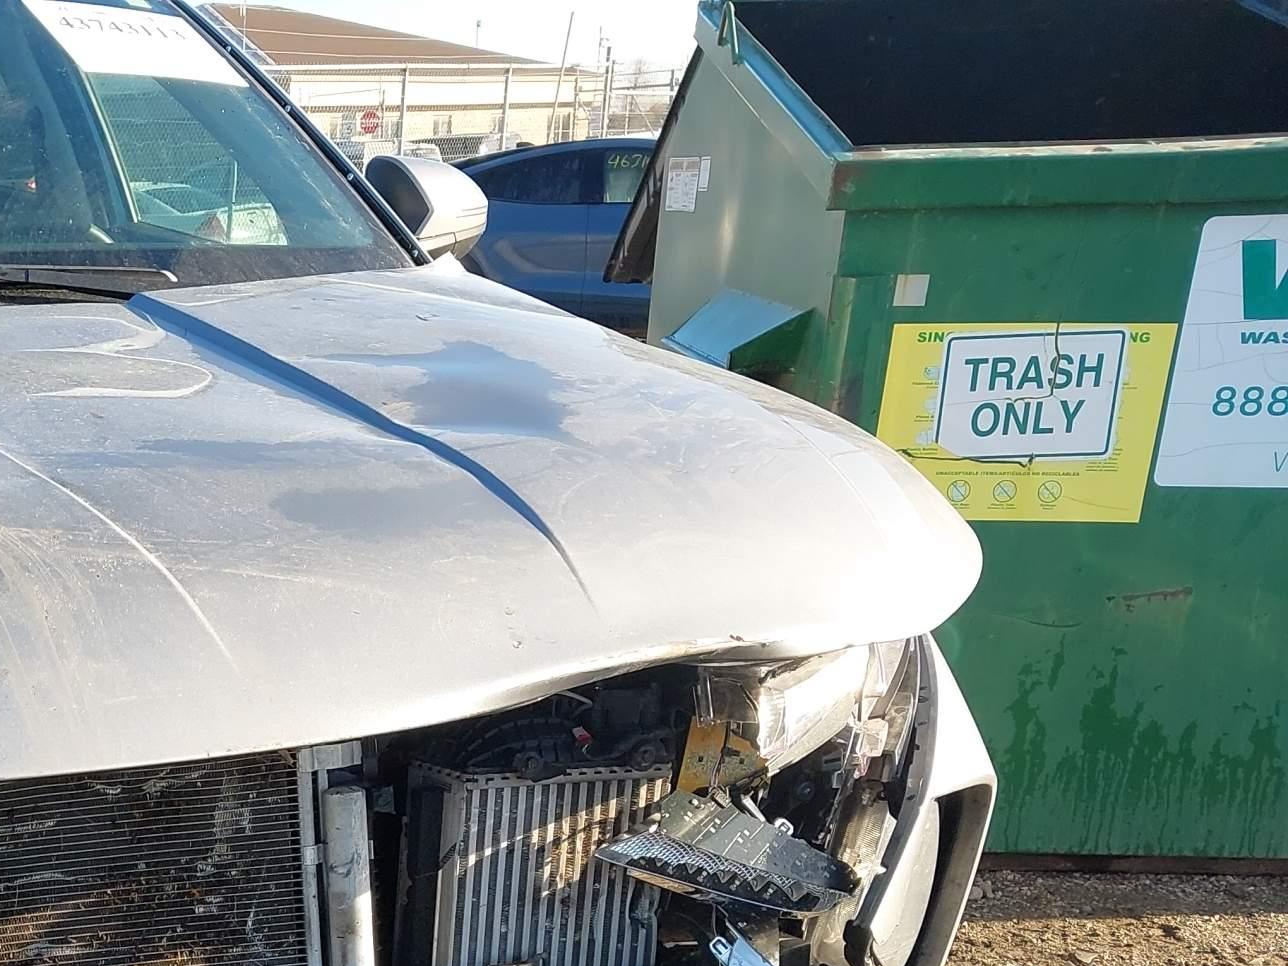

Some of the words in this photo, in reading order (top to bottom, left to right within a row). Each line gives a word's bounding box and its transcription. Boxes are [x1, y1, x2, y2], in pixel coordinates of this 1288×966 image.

[917, 331, 949, 343] SIN
[965, 352, 1105, 392] TRASH
[971, 399, 1086, 437] ONLY
